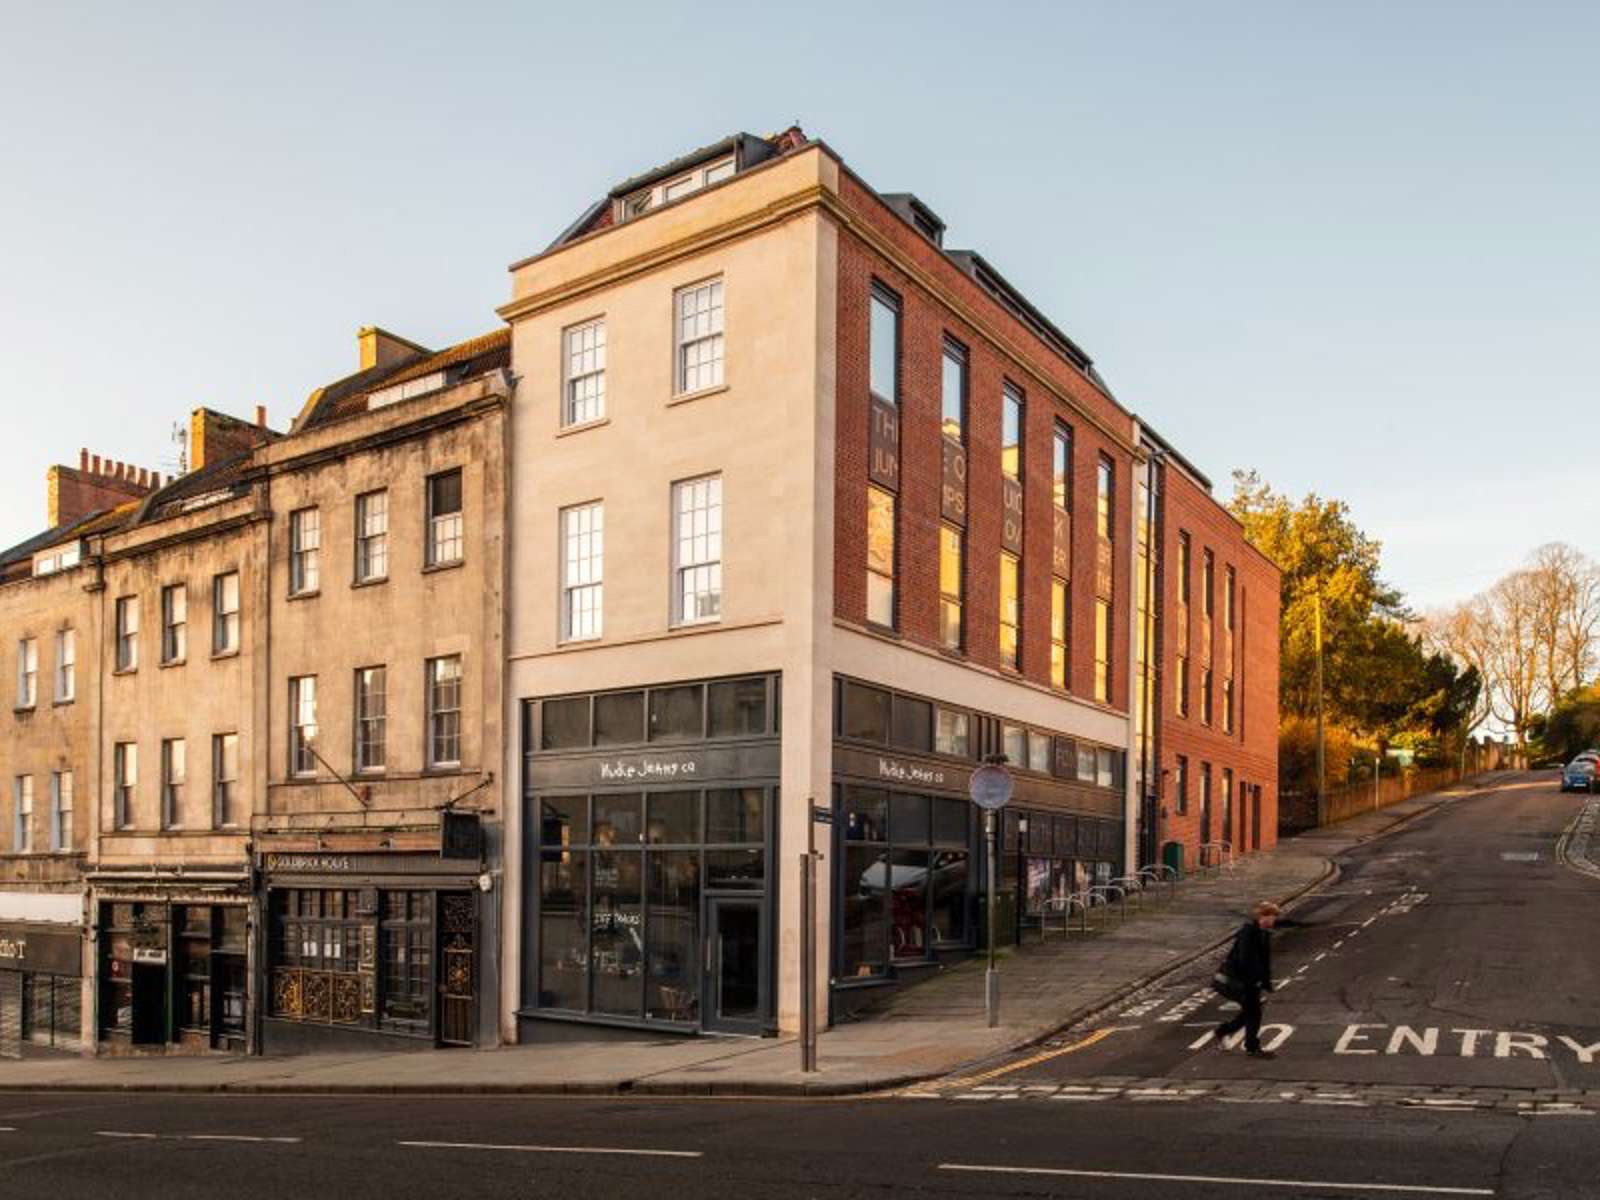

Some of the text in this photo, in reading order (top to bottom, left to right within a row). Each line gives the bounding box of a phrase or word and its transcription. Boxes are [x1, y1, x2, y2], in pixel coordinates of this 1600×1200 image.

[872, 405, 899, 443] TH
[1187, 1023, 1600, 1063] NO ENTRY
